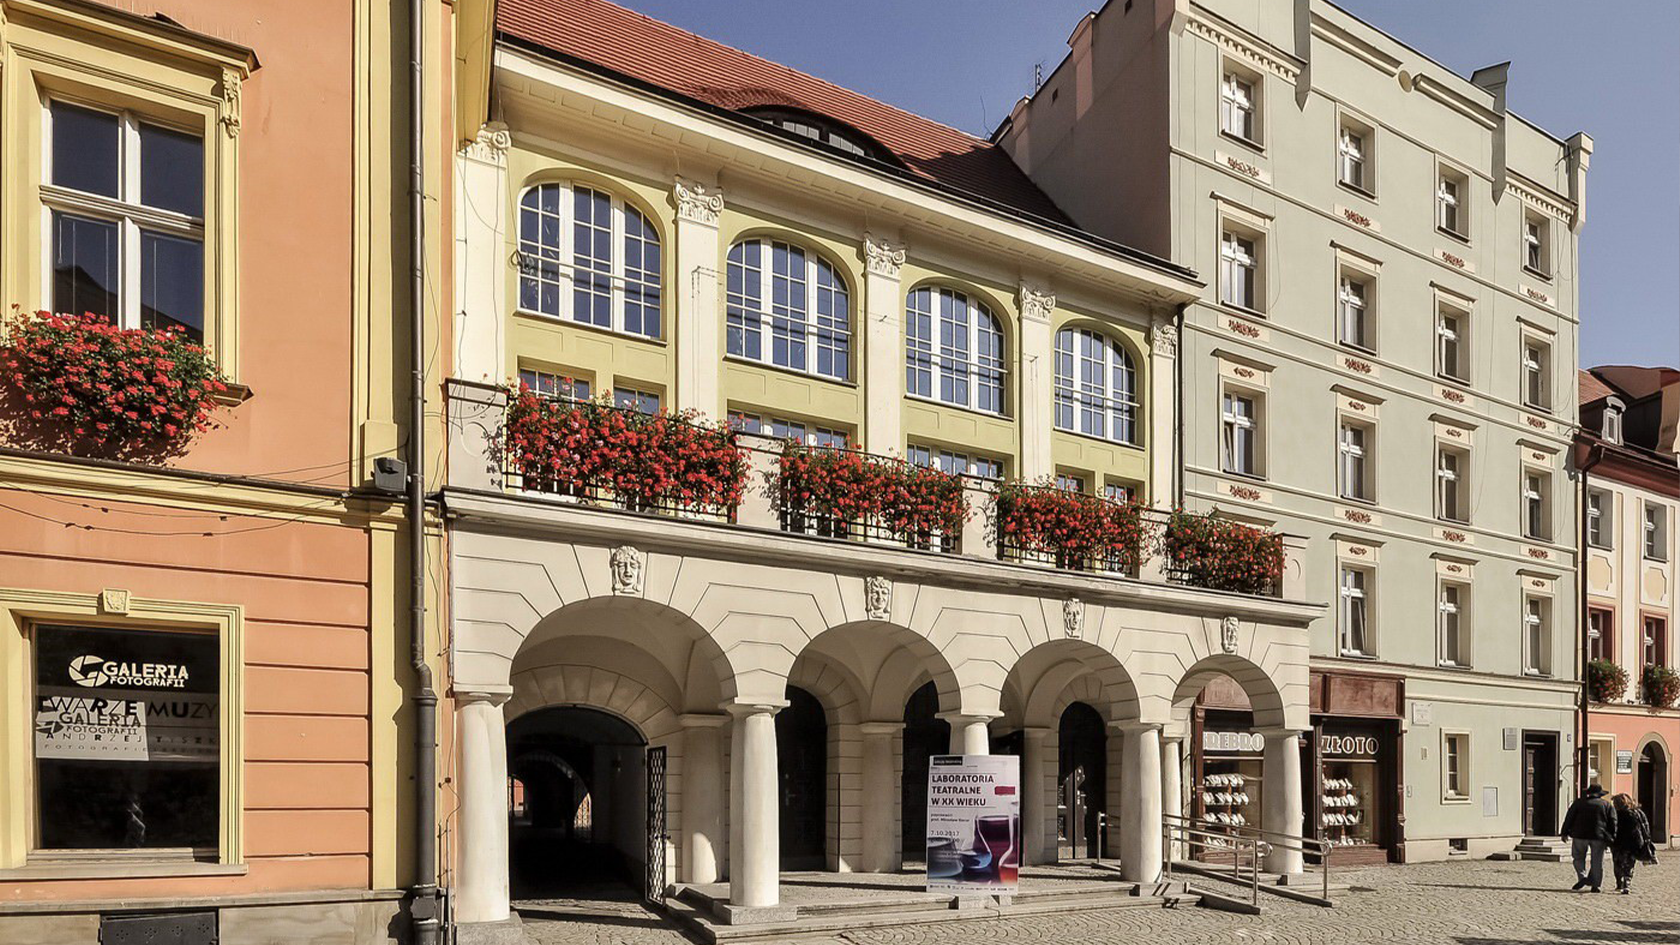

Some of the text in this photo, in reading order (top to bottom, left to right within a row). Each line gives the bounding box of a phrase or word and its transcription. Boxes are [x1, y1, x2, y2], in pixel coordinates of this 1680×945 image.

[102, 661, 189, 680] GALERIA
[109, 676, 185, 688] FOTOGRAFII
[59, 712, 142, 728] GALERIA
[46, 731, 143, 743] ANDRZEJ
[931, 774, 994, 783] LABORATORIA
[931, 785, 982, 794] TEATRALNE
[931, 797, 986, 806] W XX WIEKU
